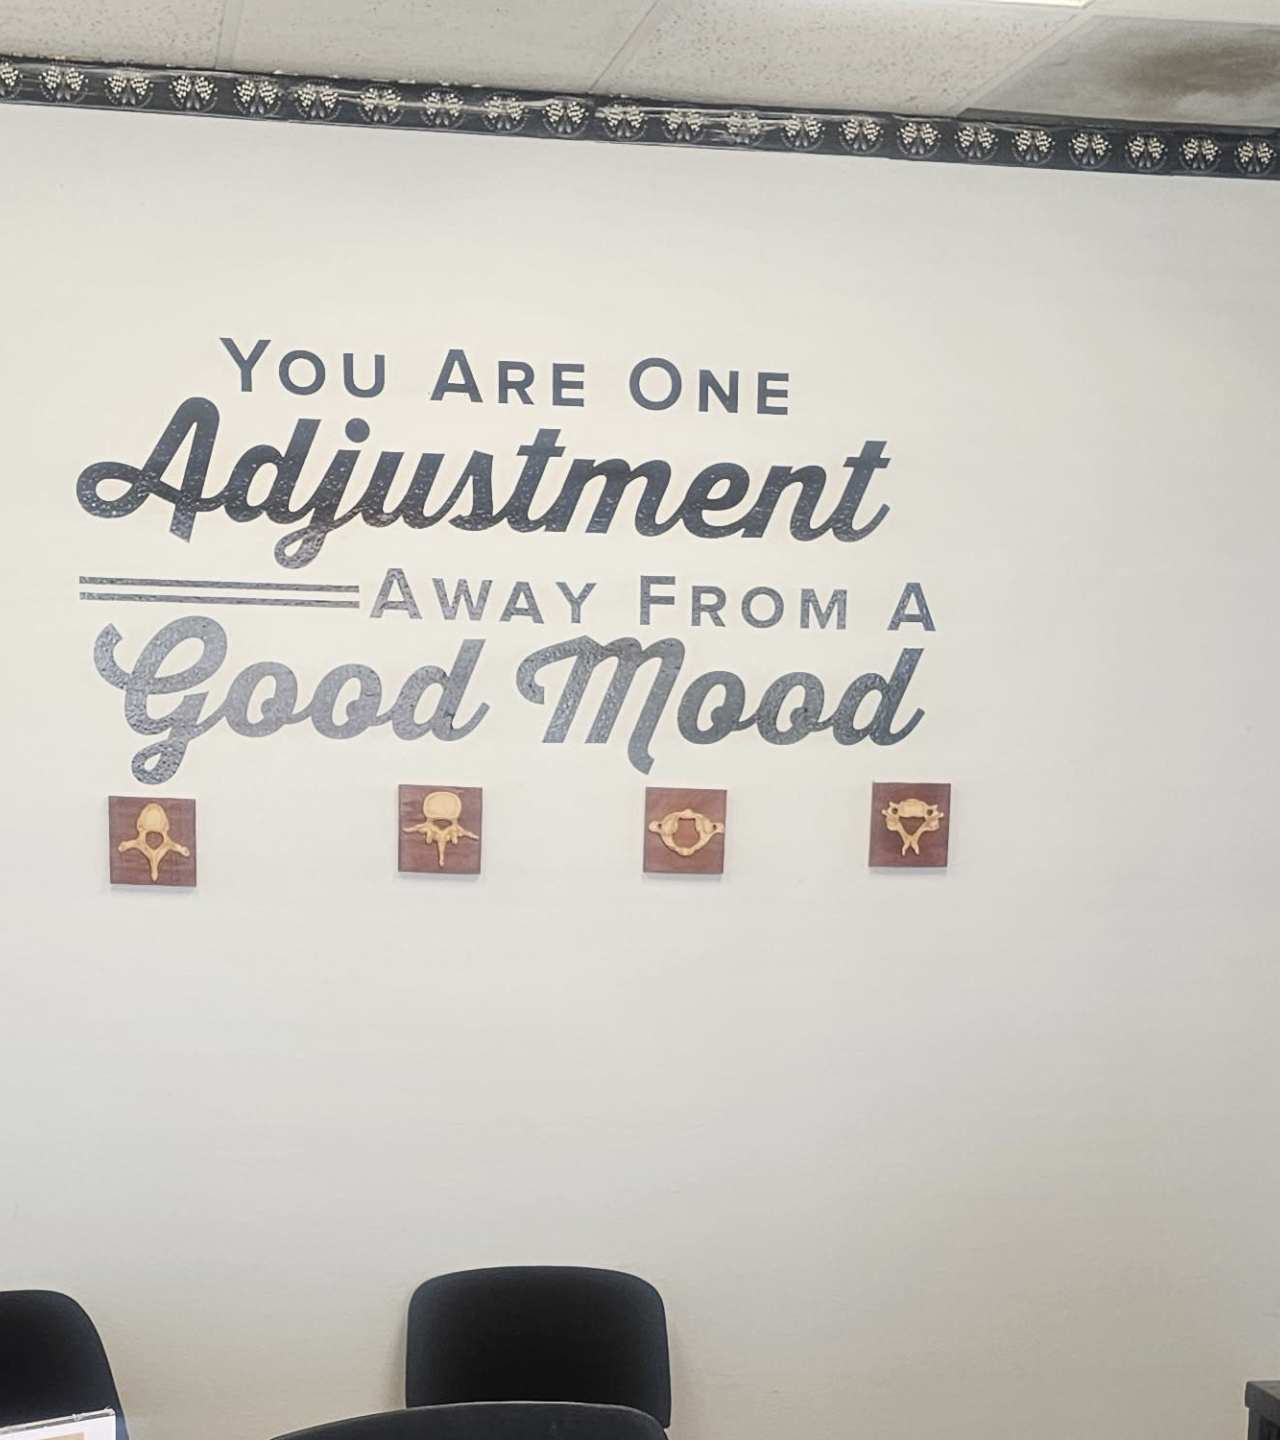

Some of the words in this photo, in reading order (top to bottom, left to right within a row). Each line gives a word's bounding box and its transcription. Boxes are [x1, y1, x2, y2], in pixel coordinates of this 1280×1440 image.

[219, 336, 387, 401] YOU
[432, 349, 586, 409] ARE
[628, 357, 791, 415] ONE
[76, 397, 891, 570] Adjustment
[369, 567, 598, 626] AWAY
[639, 574, 848, 632] FROM
[887, 582, 936, 632] A
[94, 616, 490, 786] Good
[516, 636, 926, 776] Mood
